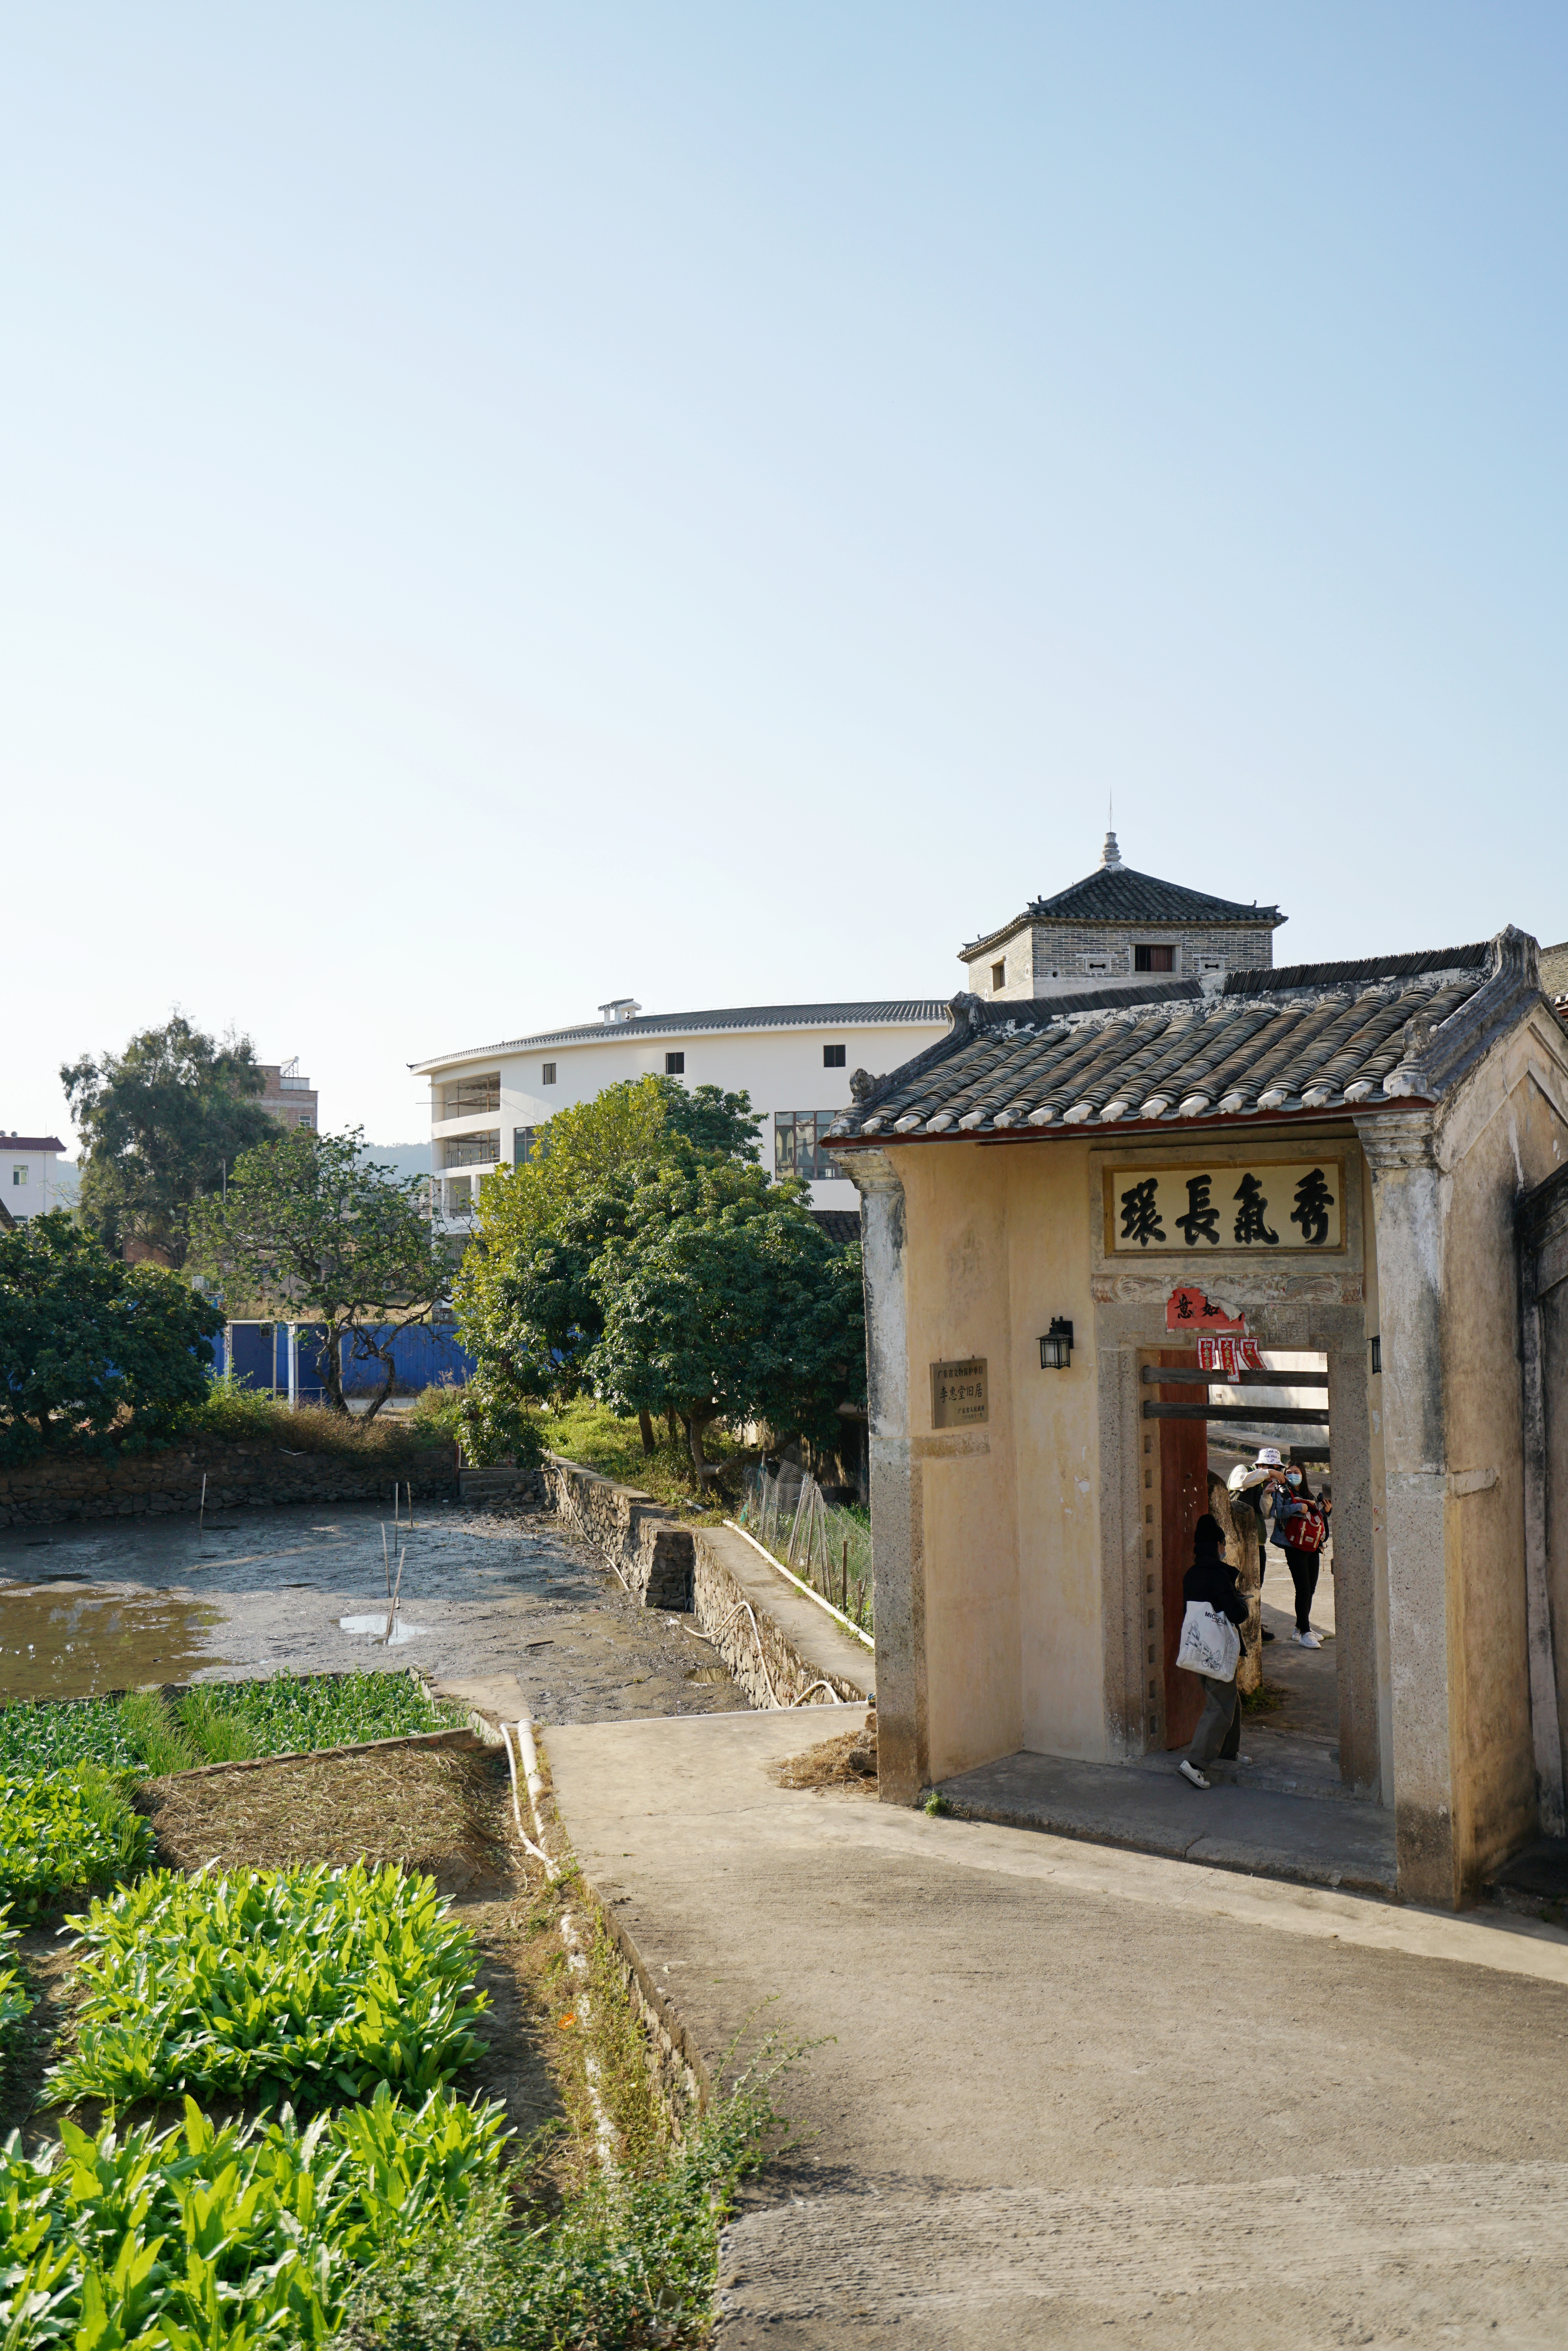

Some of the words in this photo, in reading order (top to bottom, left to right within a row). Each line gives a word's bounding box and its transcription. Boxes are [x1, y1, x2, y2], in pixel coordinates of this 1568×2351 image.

[938, 1366, 983, 1379] 广东省文物保护单位
[940, 1383, 983, 1403] 李惠堂旧居
[958, 1405, 984, 1414] 广东省人民政府
